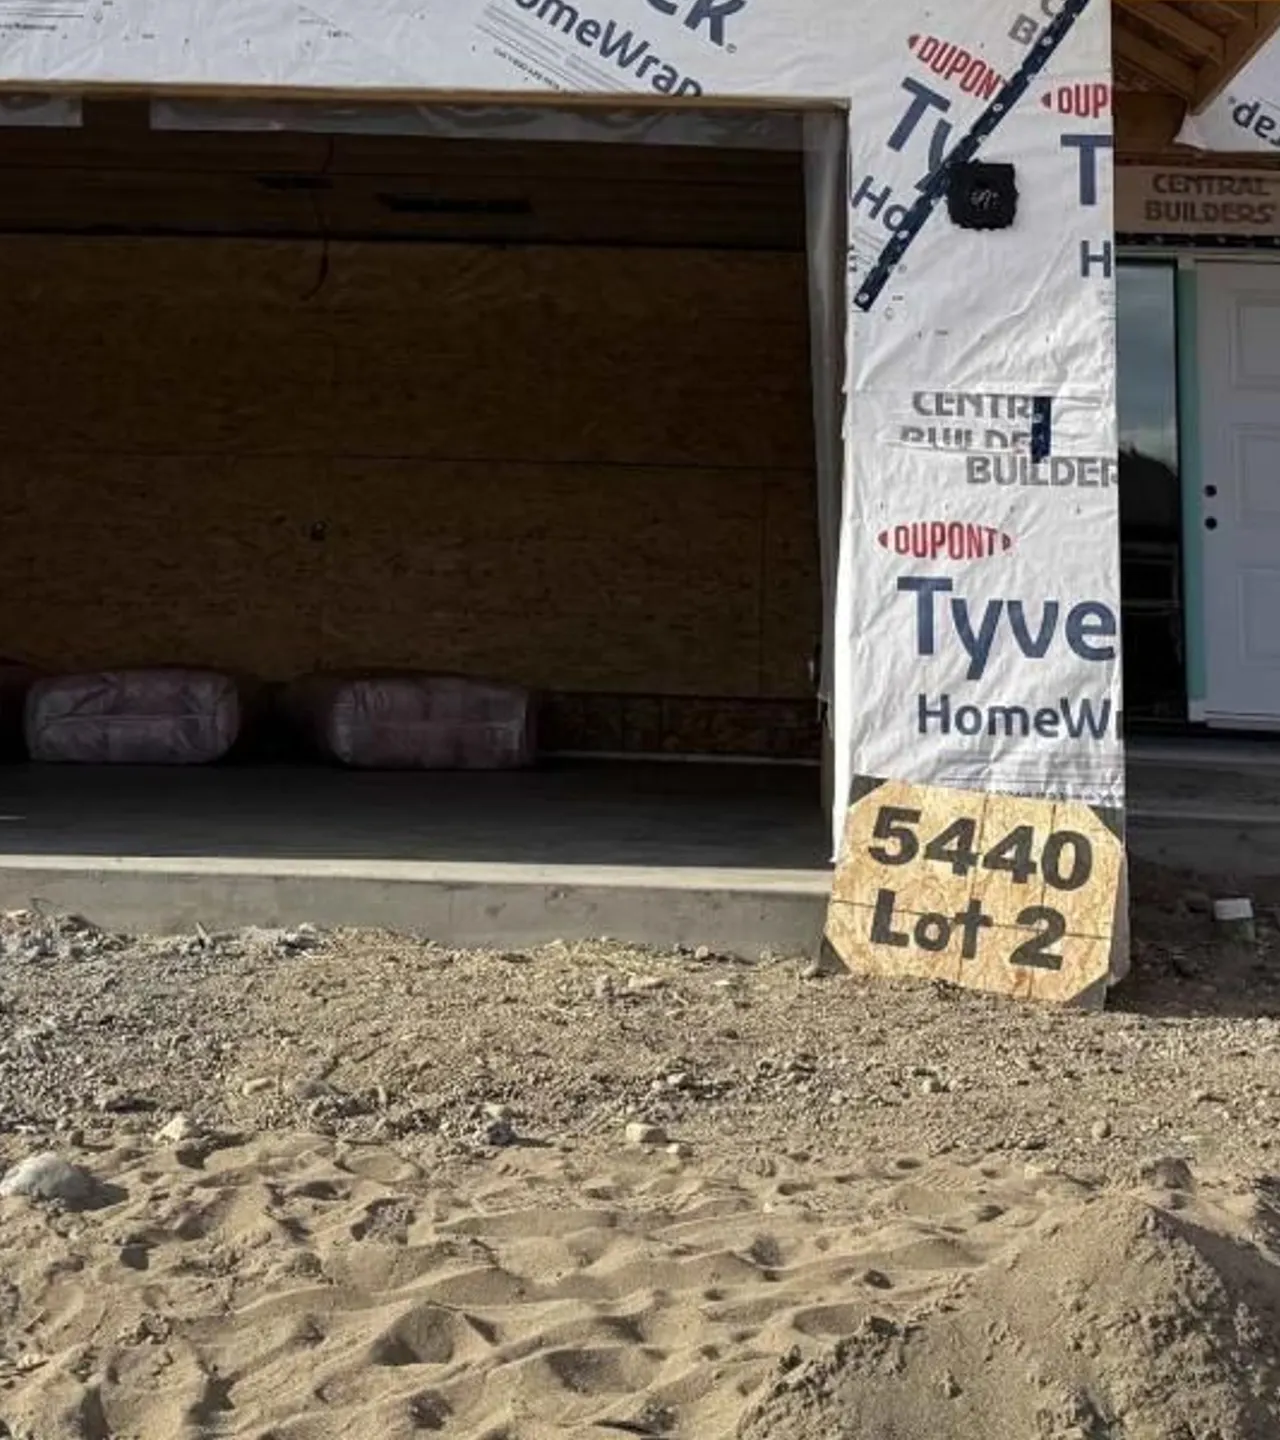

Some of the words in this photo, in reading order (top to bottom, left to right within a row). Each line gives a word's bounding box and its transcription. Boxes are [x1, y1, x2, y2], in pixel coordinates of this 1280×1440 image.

[1058, 82, 1111, 118] DUP
[1152, 173, 1272, 196] CENTRAL
[912, 392, 1032, 419] CENTR
[894, 521, 999, 560] DUPONT
[897, 576, 1117, 680] Tyve
[868, 805, 1093, 892] 5440
[870, 888, 993, 960] Lot
[1009, 905, 1066, 971] 2
